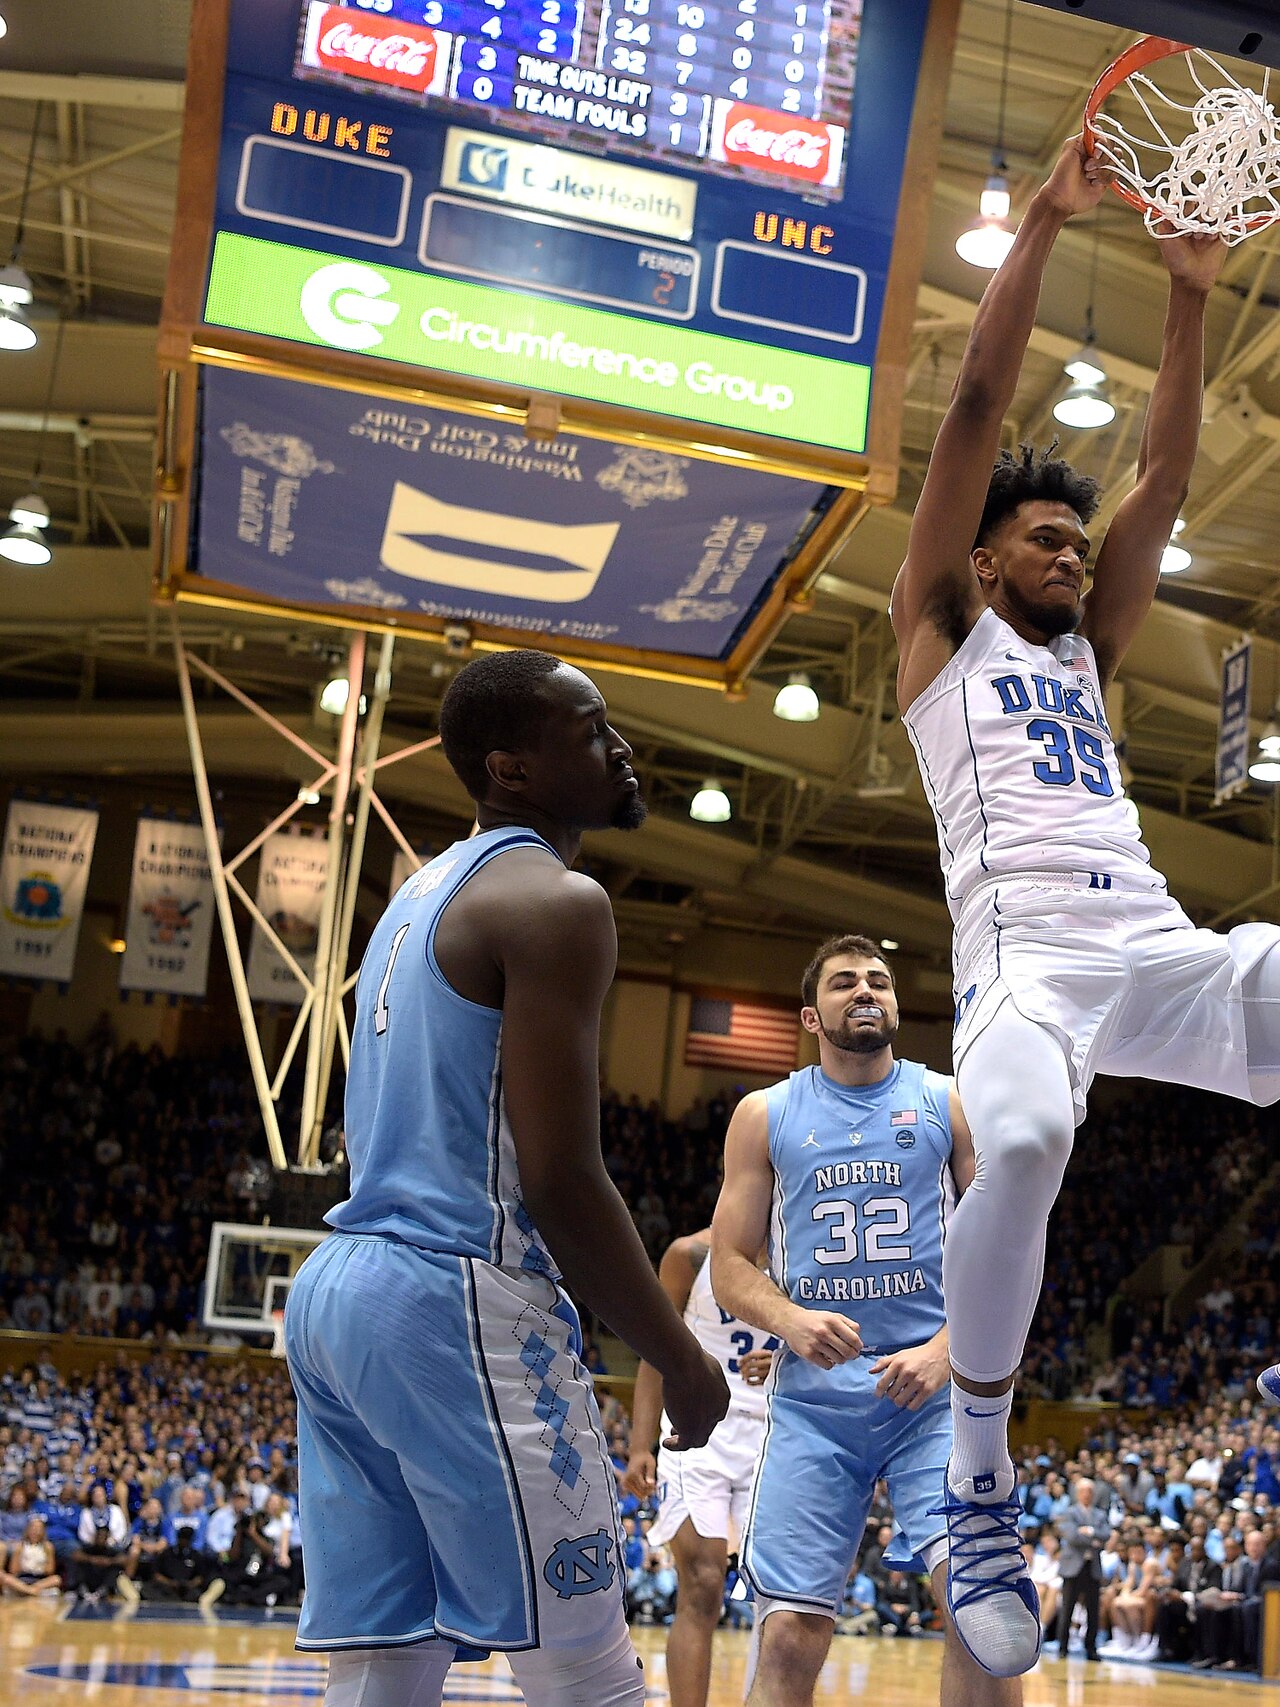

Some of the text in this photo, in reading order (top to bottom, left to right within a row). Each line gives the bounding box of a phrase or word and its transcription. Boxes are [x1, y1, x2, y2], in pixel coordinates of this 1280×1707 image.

[423, 1, 557, 53] 3 4 2
[677, 4, 705, 29] 10
[735, 20, 755, 42] 4
[791, 32, 804, 54] 1
[794, 4, 807, 27] 1
[614, 17, 651, 46] 24
[732, 47, 752, 70] 0
[784, 60, 804, 83] 0
[477, 46, 688, 116] 3 TIME OUTS LEFT 3
[611, 47, 801, 112] 32 7 4 2
[271, 101, 394, 158] DUKE
[472, 76, 682, 145] 0 TEAM FOULS 1
[754, 210, 836, 256] UNC
[637, 250, 693, 277] PERIOD
[653, 272, 676, 305] 2
[420, 306, 795, 412] Circumference Group
[363, 408, 432, 436] Club
[435, 423, 499, 449] Golf
[349, 424, 583, 482] Washington Duke
[534, 441, 578, 462] Inn
[1026, 718, 1115, 798] 35
[373, 922, 411, 1036] 1
[814, 1160, 902, 1193] NORTH
[811, 1196, 912, 1266] 32
[799, 1268, 926, 1302] CAROLINA
[976, 1480, 993, 1491] 35
